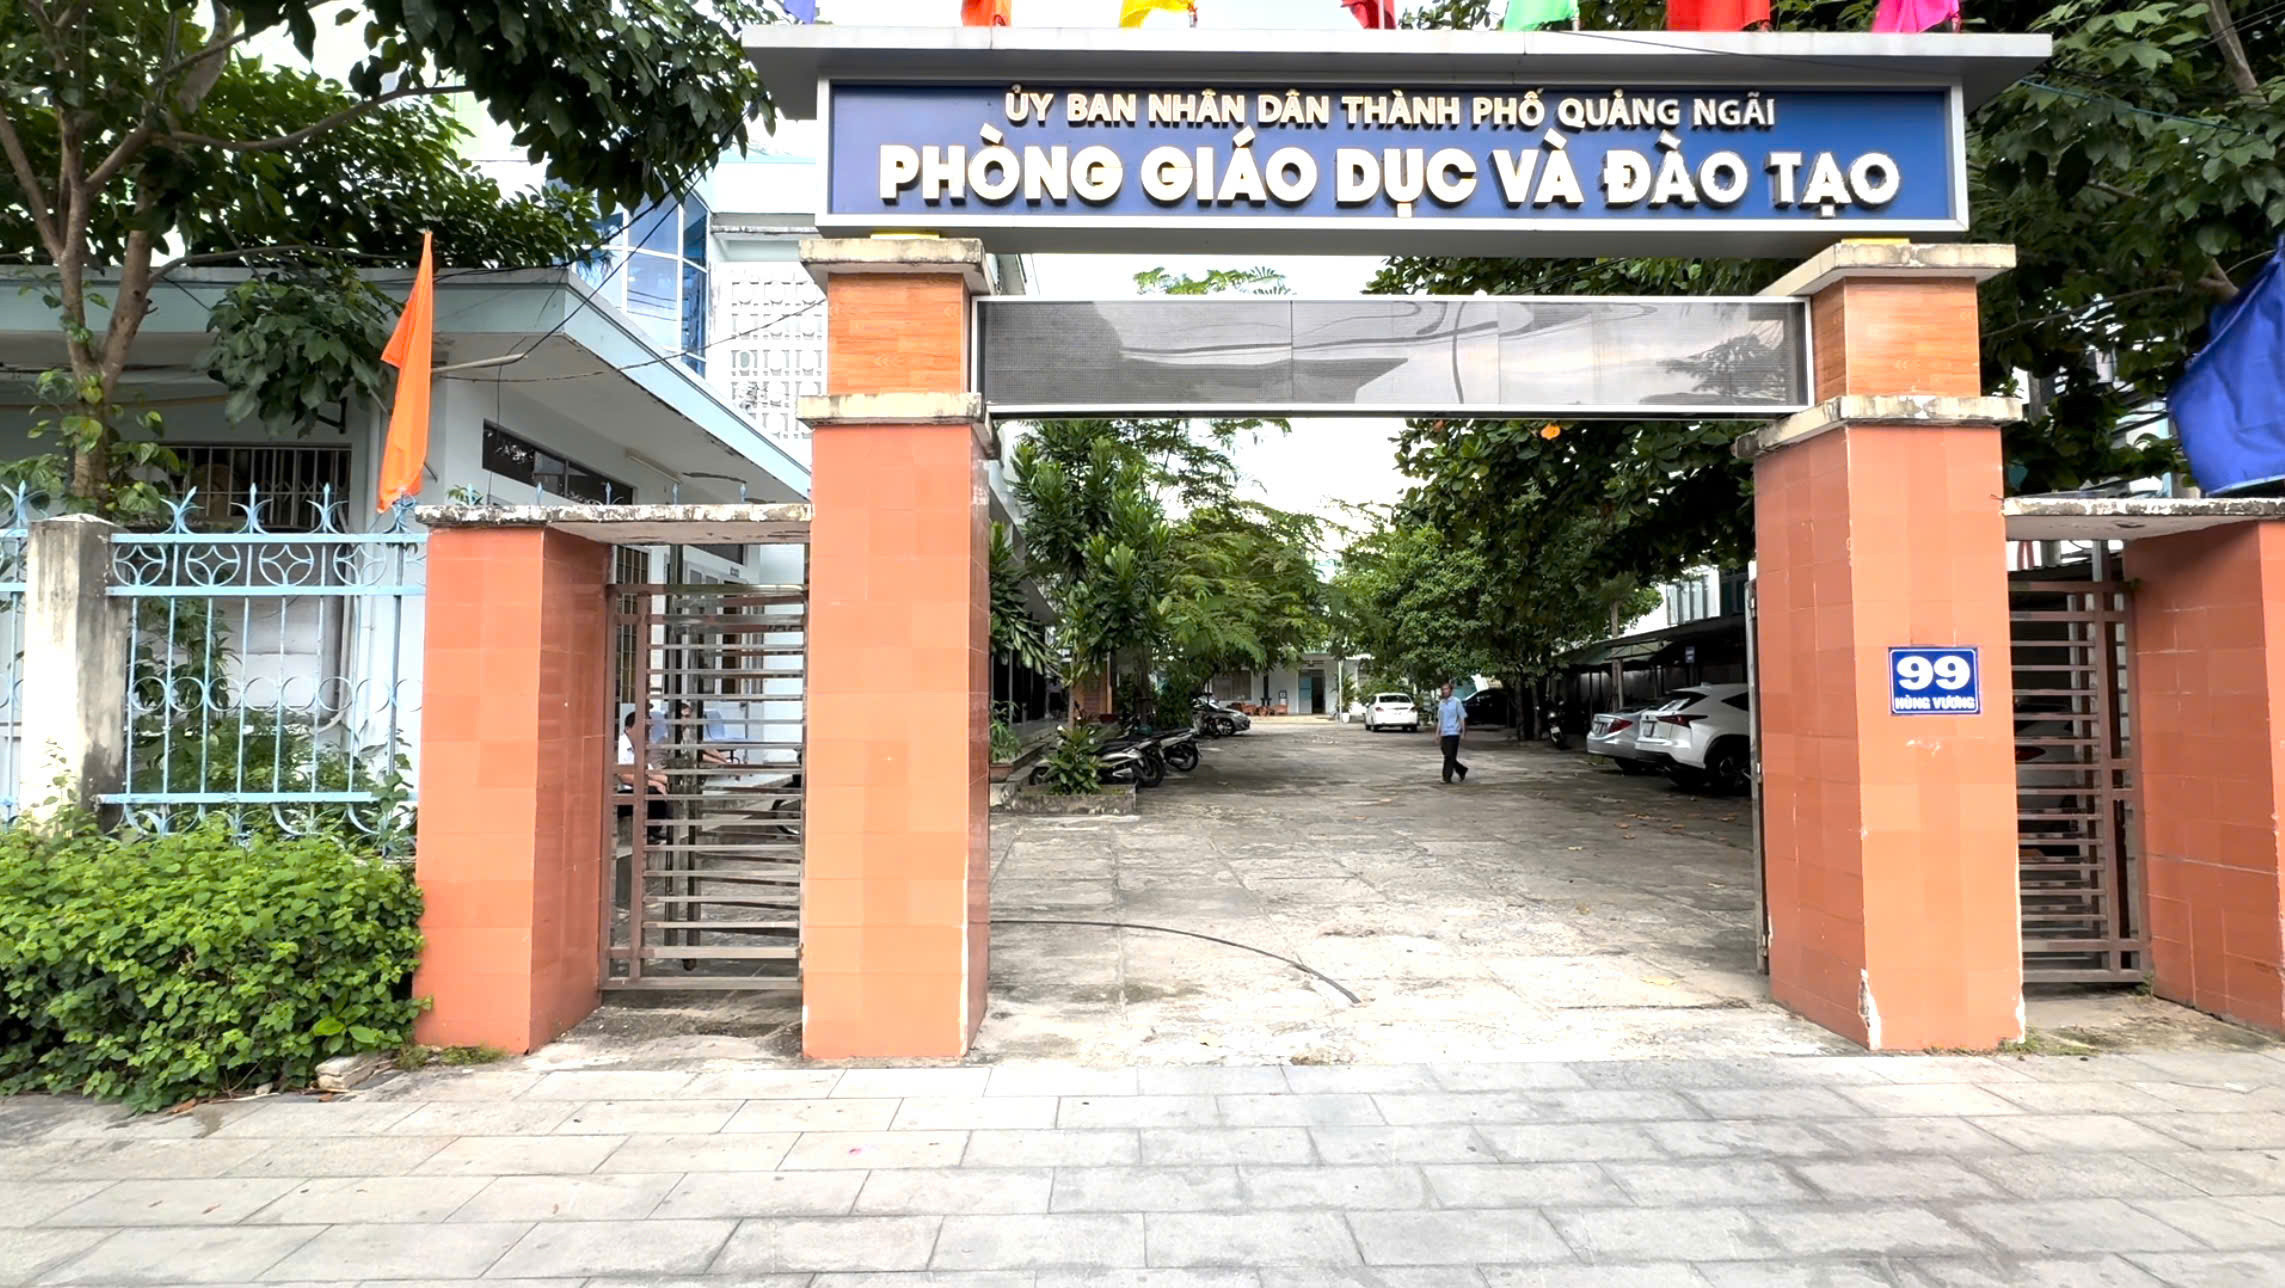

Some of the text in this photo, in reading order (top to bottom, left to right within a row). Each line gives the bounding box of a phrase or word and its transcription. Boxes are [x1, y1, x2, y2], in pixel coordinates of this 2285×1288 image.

[1005, 84, 1775, 128] ỦY BAN NHÂN DÂN THÀNH PHỐ QUẢNG NGÃI
[880, 123, 1900, 217] PHÒNG GIÁO DỤC VÀ ĐÀO TẠO
[1896, 655, 1971, 690] 99
